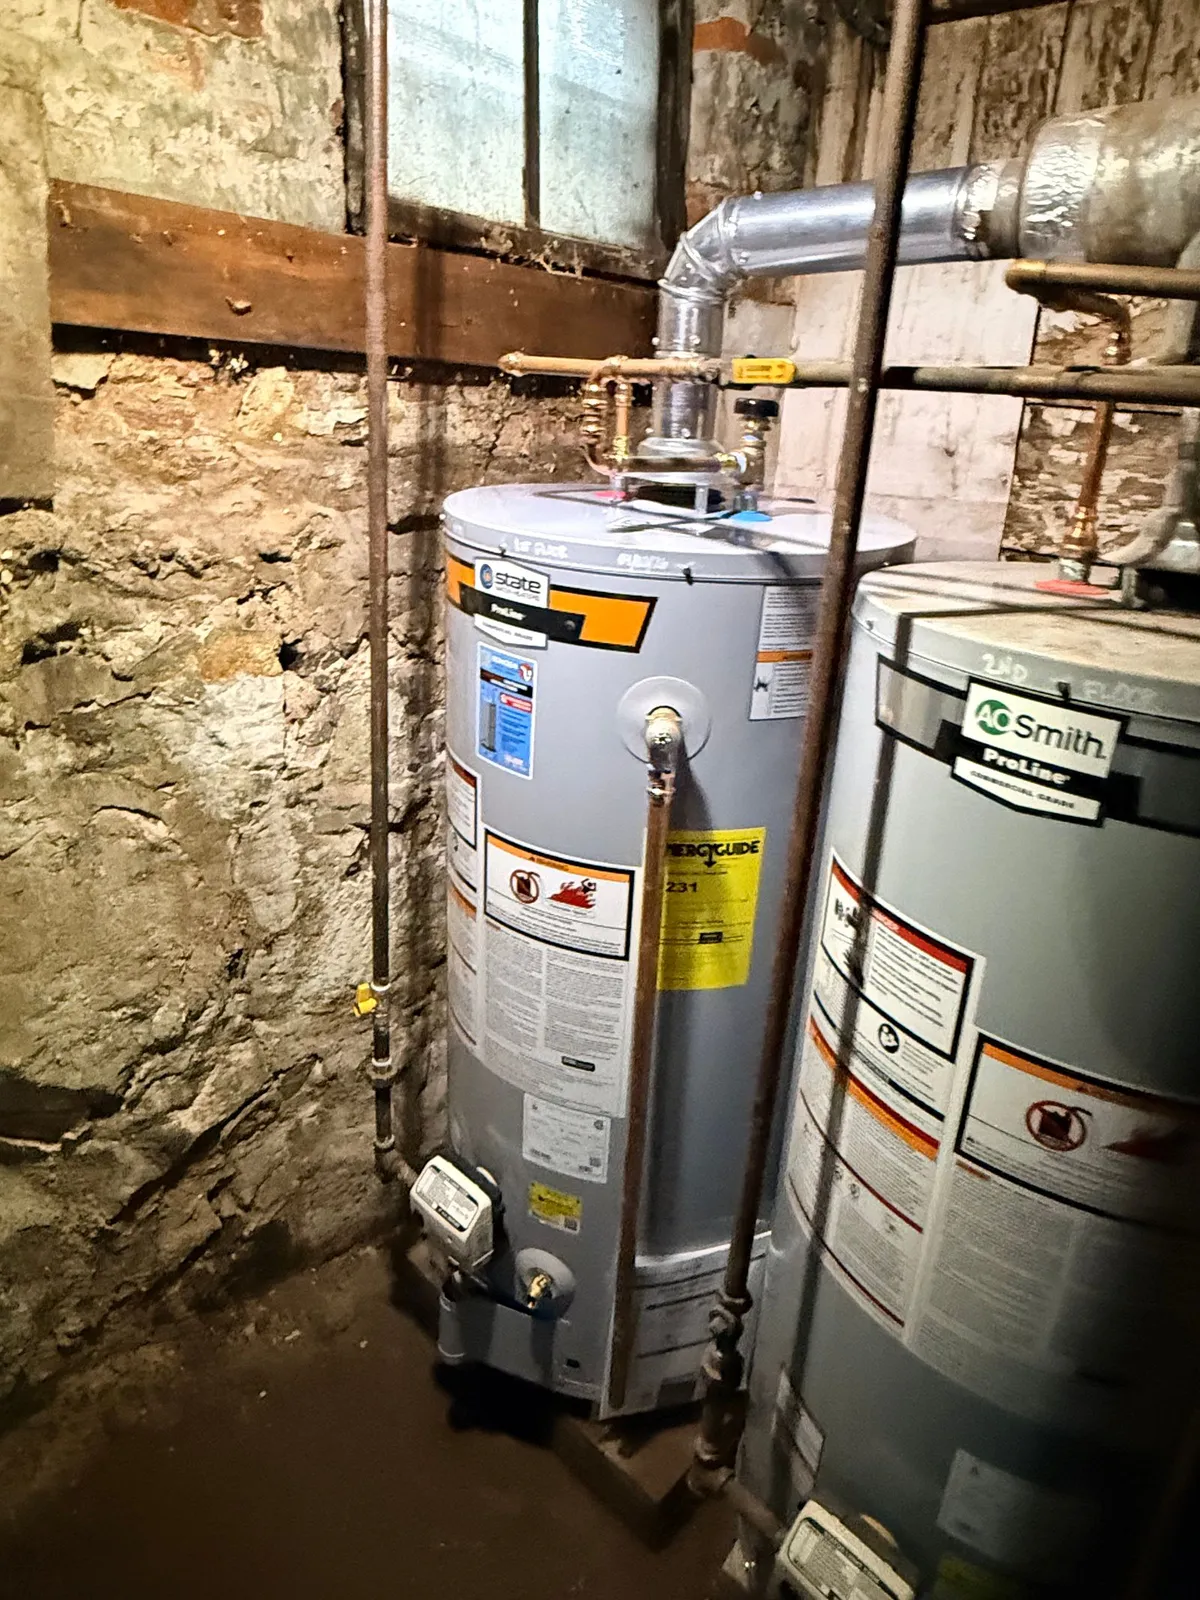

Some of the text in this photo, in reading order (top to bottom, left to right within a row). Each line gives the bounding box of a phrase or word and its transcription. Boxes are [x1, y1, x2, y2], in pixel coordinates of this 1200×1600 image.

[495, 572, 540, 594] state
[981, 653, 1028, 681] 2ND
[1014, 714, 1104, 759] Smith
[983, 747, 1066, 784] ProLine
[665, 881, 697, 893] 231
